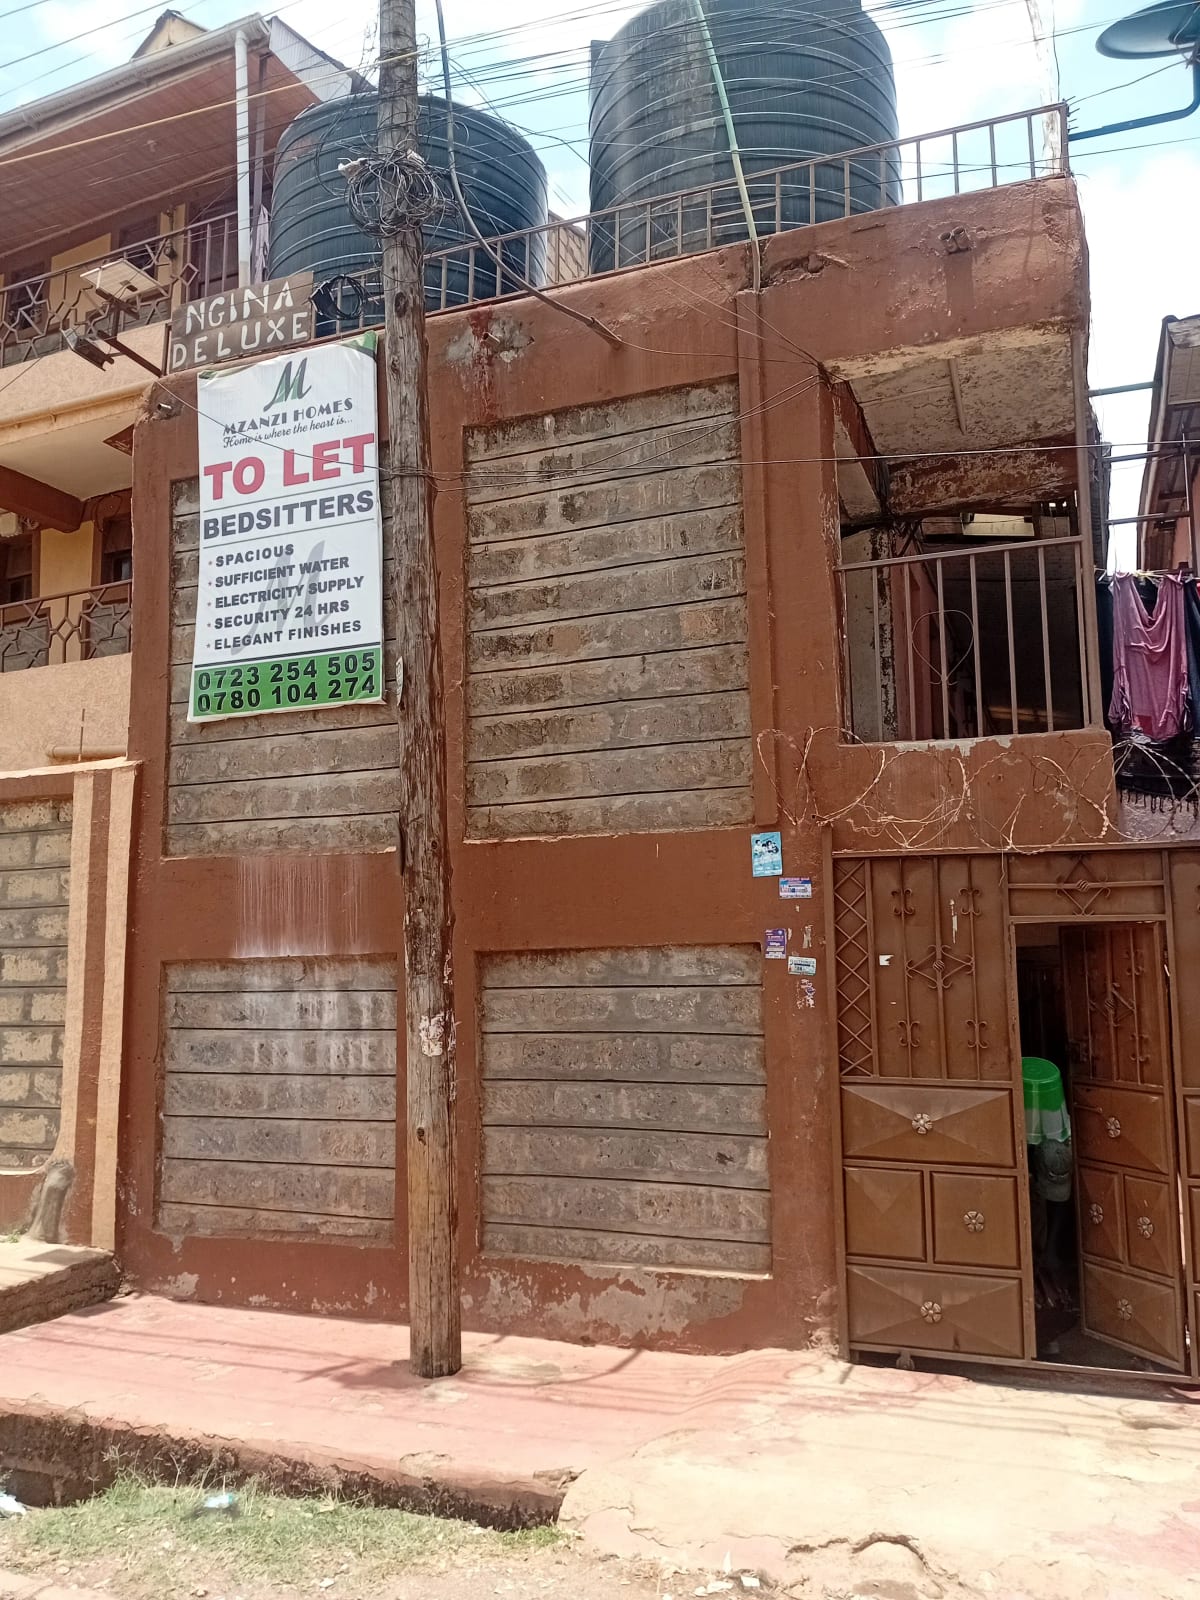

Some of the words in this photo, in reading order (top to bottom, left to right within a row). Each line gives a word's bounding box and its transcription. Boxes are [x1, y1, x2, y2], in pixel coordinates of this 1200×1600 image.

[186, 281, 294, 335] NGINA
[172, 311, 308, 369] DELUXE
[222, 412, 287, 436] MZANZI
[293, 397, 353, 422] HOMES
[223, 436, 253, 448] Home
[264, 427, 292, 440] where
[293, 422, 308, 434] the
[309, 418, 335, 431] heart
[203, 456, 266, 501] TO
[283, 432, 375, 487] LET
[203, 490, 374, 540] BEDSITTERS
[215, 543, 294, 567] SPACIOUS
[215, 564, 296, 588] SUFFICIENT
[299, 556, 350, 575] WATER
[215, 584, 305, 609] ELECTRICITY
[308, 575, 365, 595] SUPPLY
[214, 607, 291, 630] SECURITY
[294, 604, 313, 618] 24
[317, 599, 350, 615] HRS
[214, 630, 283, 650] ELEGANT
[288, 619, 362, 641] FINISHES
[197, 666, 260, 691] 0723
[270, 659, 318, 683] 254
[327, 652, 375, 676] 505
[197, 688, 261, 713] 0780
[271, 681, 318, 704] 104
[327, 674, 375, 699] 274
